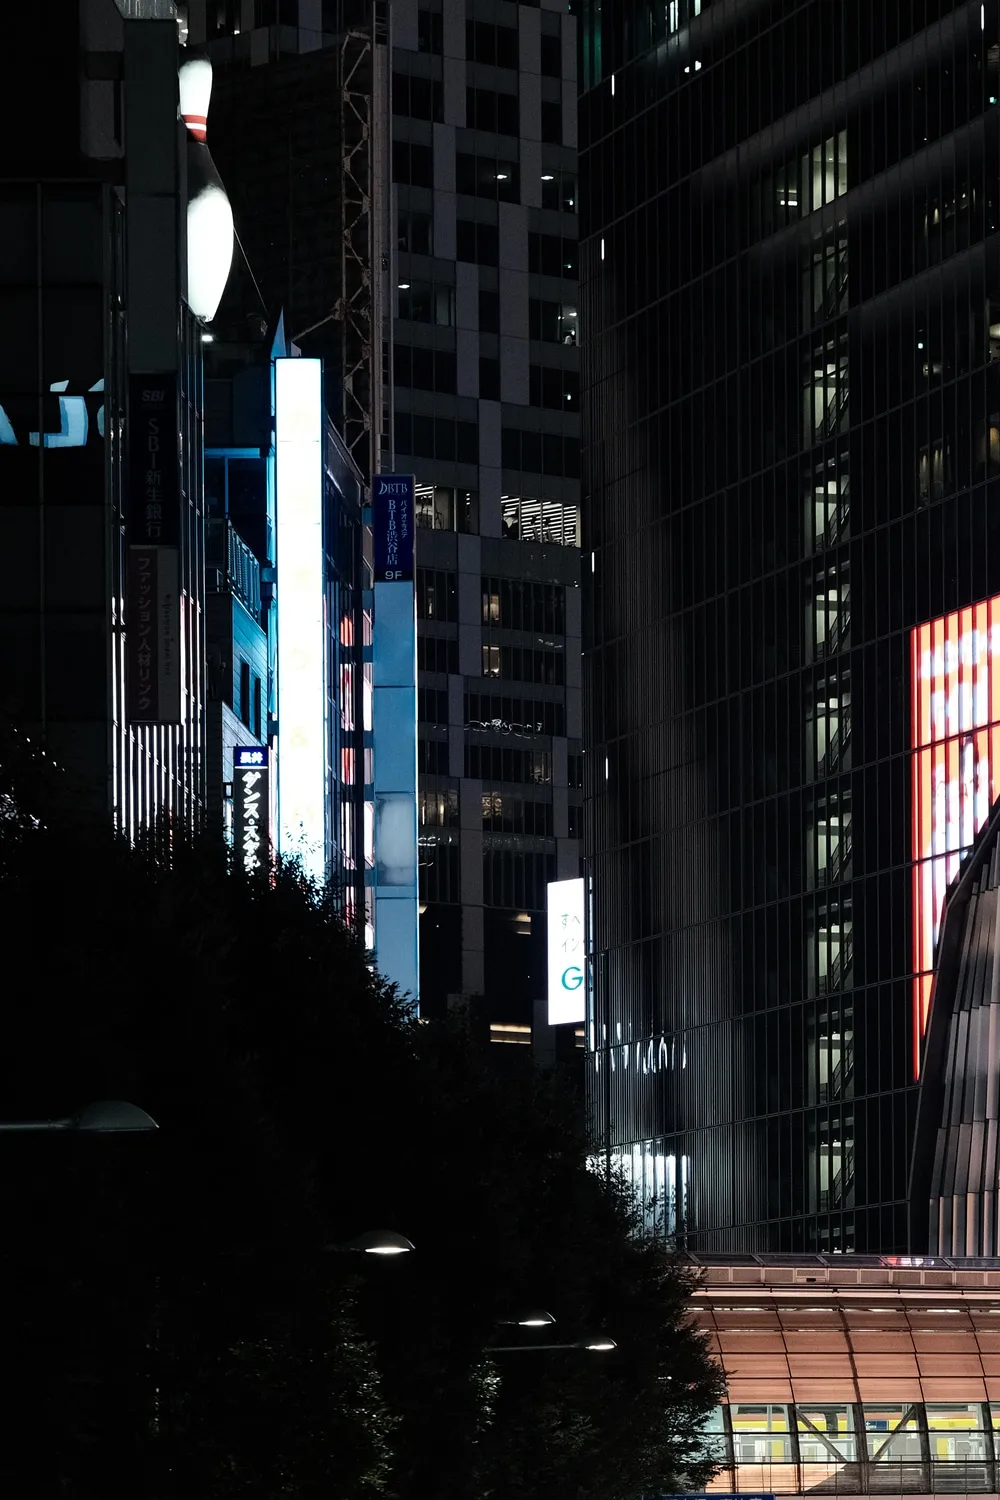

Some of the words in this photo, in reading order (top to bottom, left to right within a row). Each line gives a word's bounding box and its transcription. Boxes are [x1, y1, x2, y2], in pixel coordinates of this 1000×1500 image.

[141, 389, 165, 402] SBI
[145, 418, 163, 538] SBI新生銀行
[386, 500, 398, 565] BTB渋谷店
[385, 570, 402, 580] 9F
